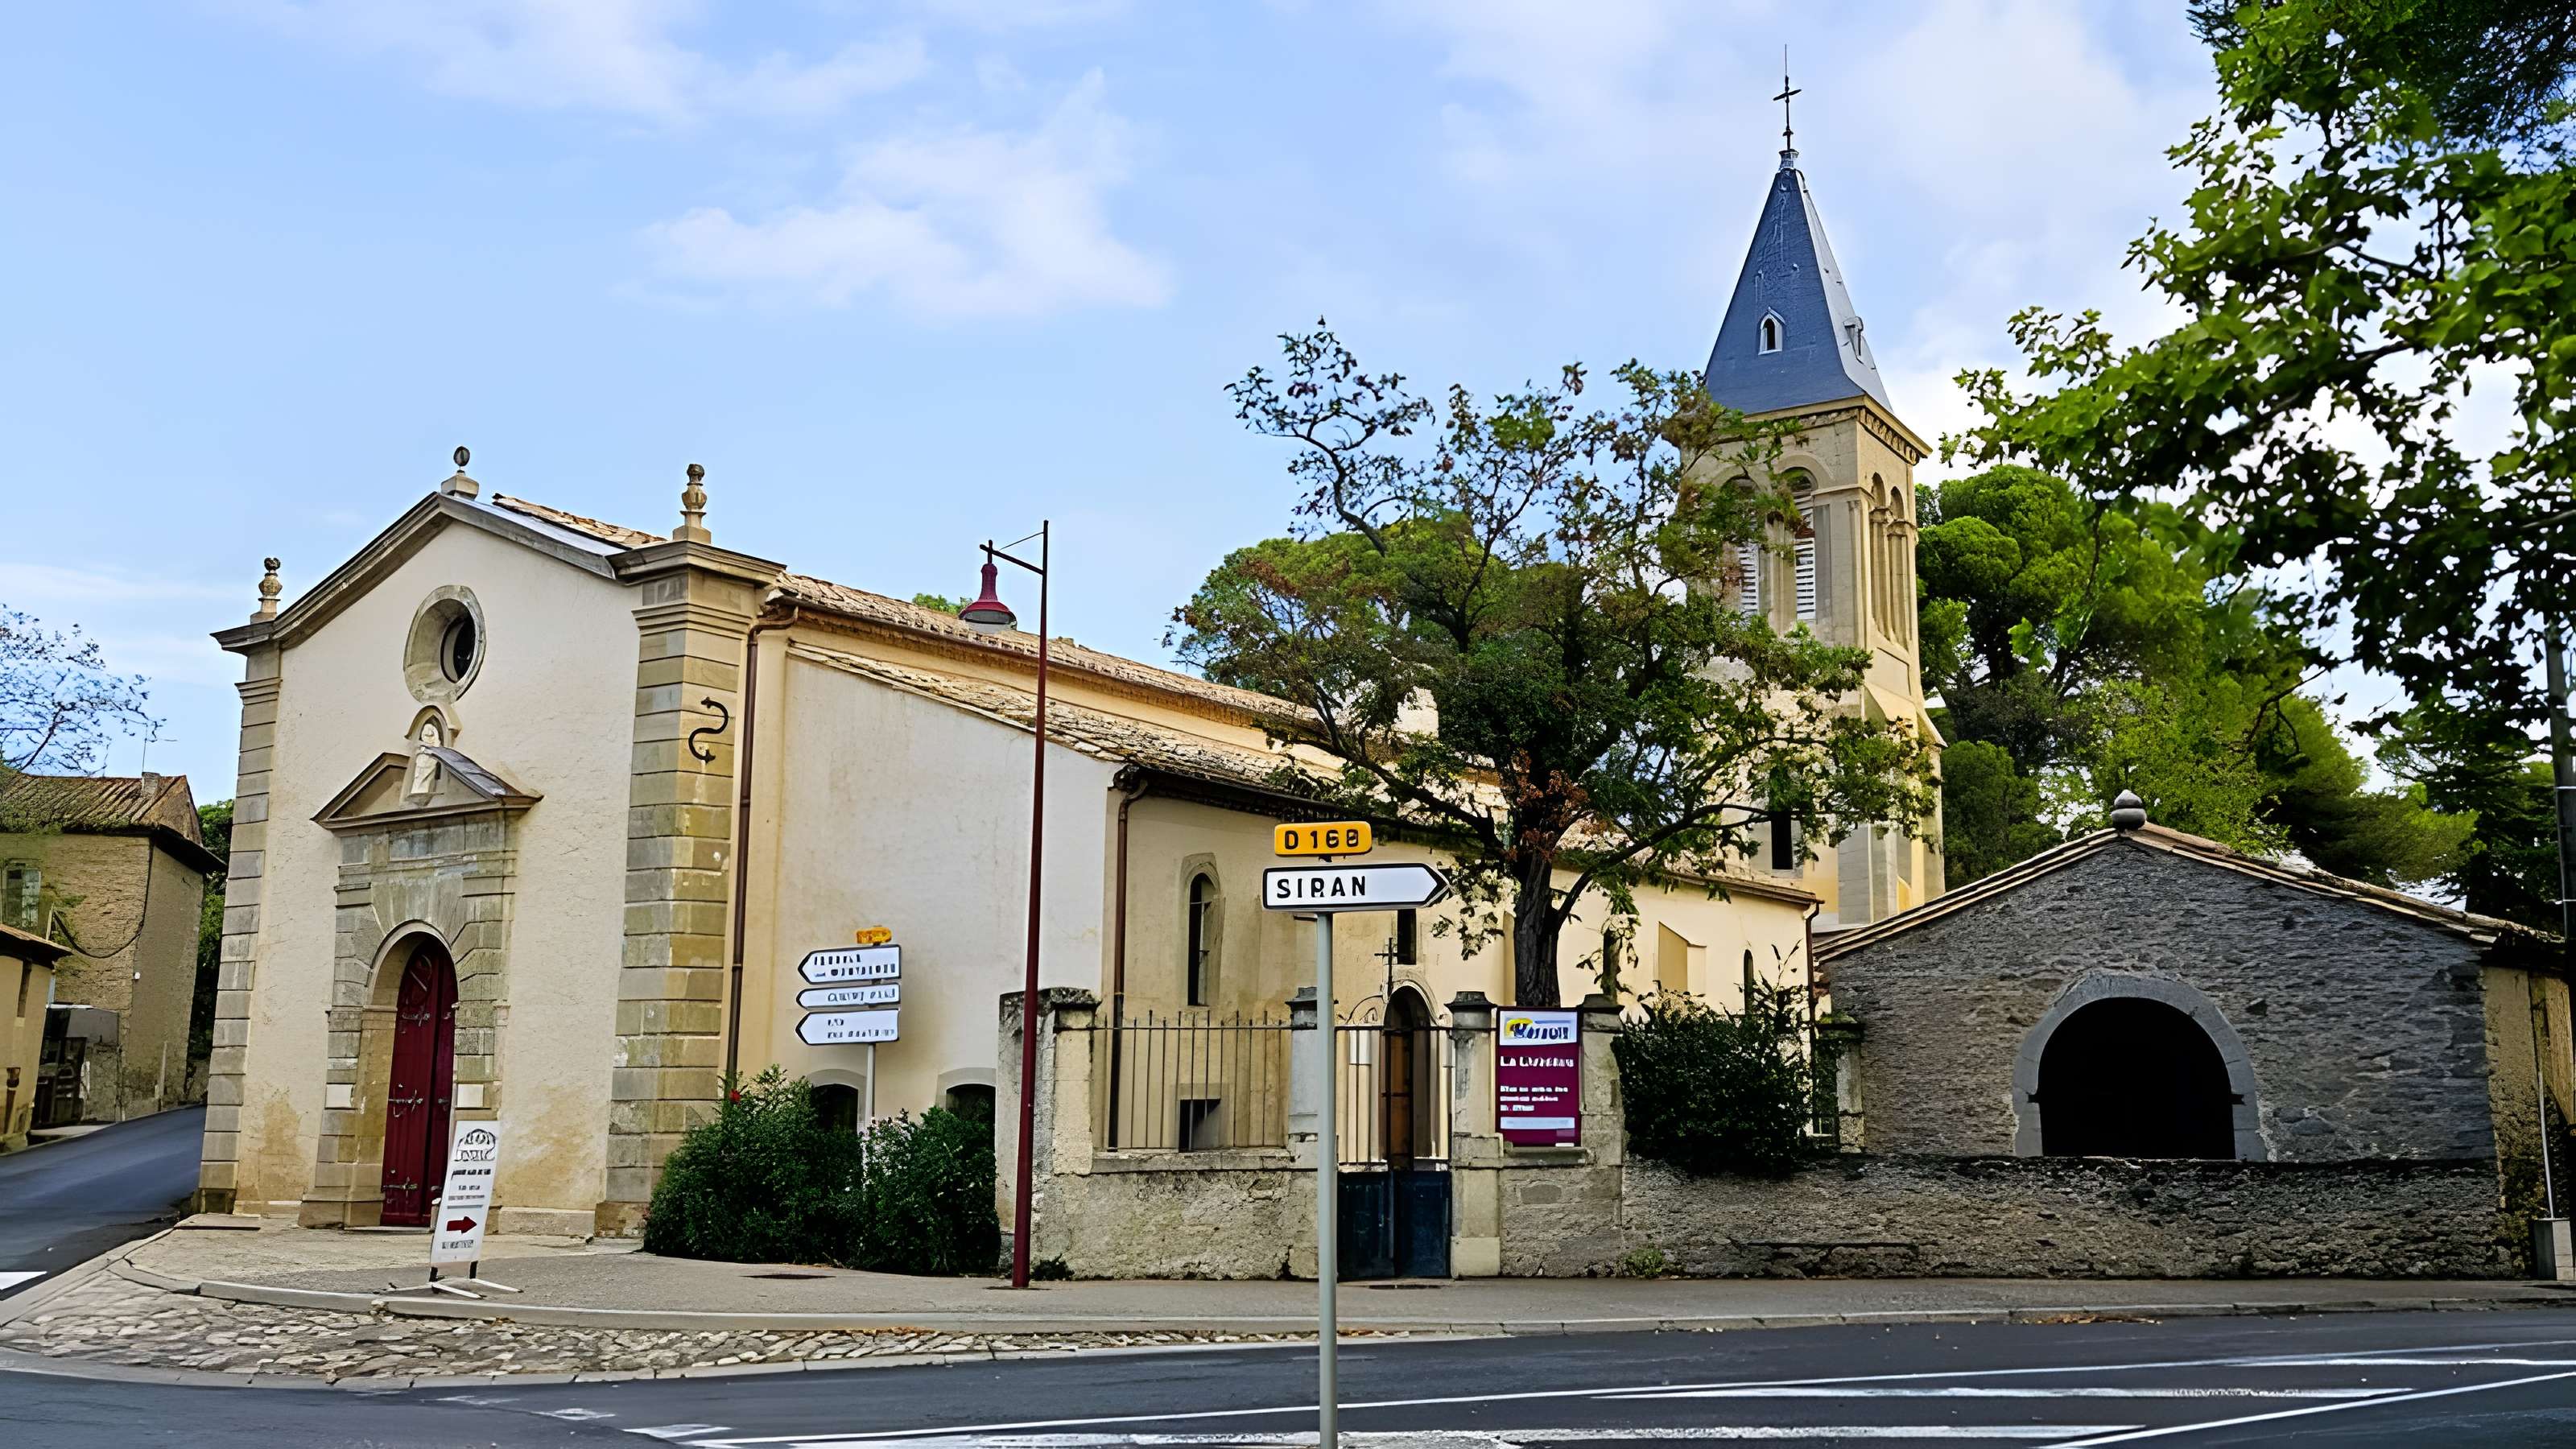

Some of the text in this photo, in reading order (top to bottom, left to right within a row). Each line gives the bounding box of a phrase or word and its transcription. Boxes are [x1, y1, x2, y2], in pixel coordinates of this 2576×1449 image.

[1284, 828, 1359, 850] D 168
[1276, 875, 1366, 899] SIRAN
